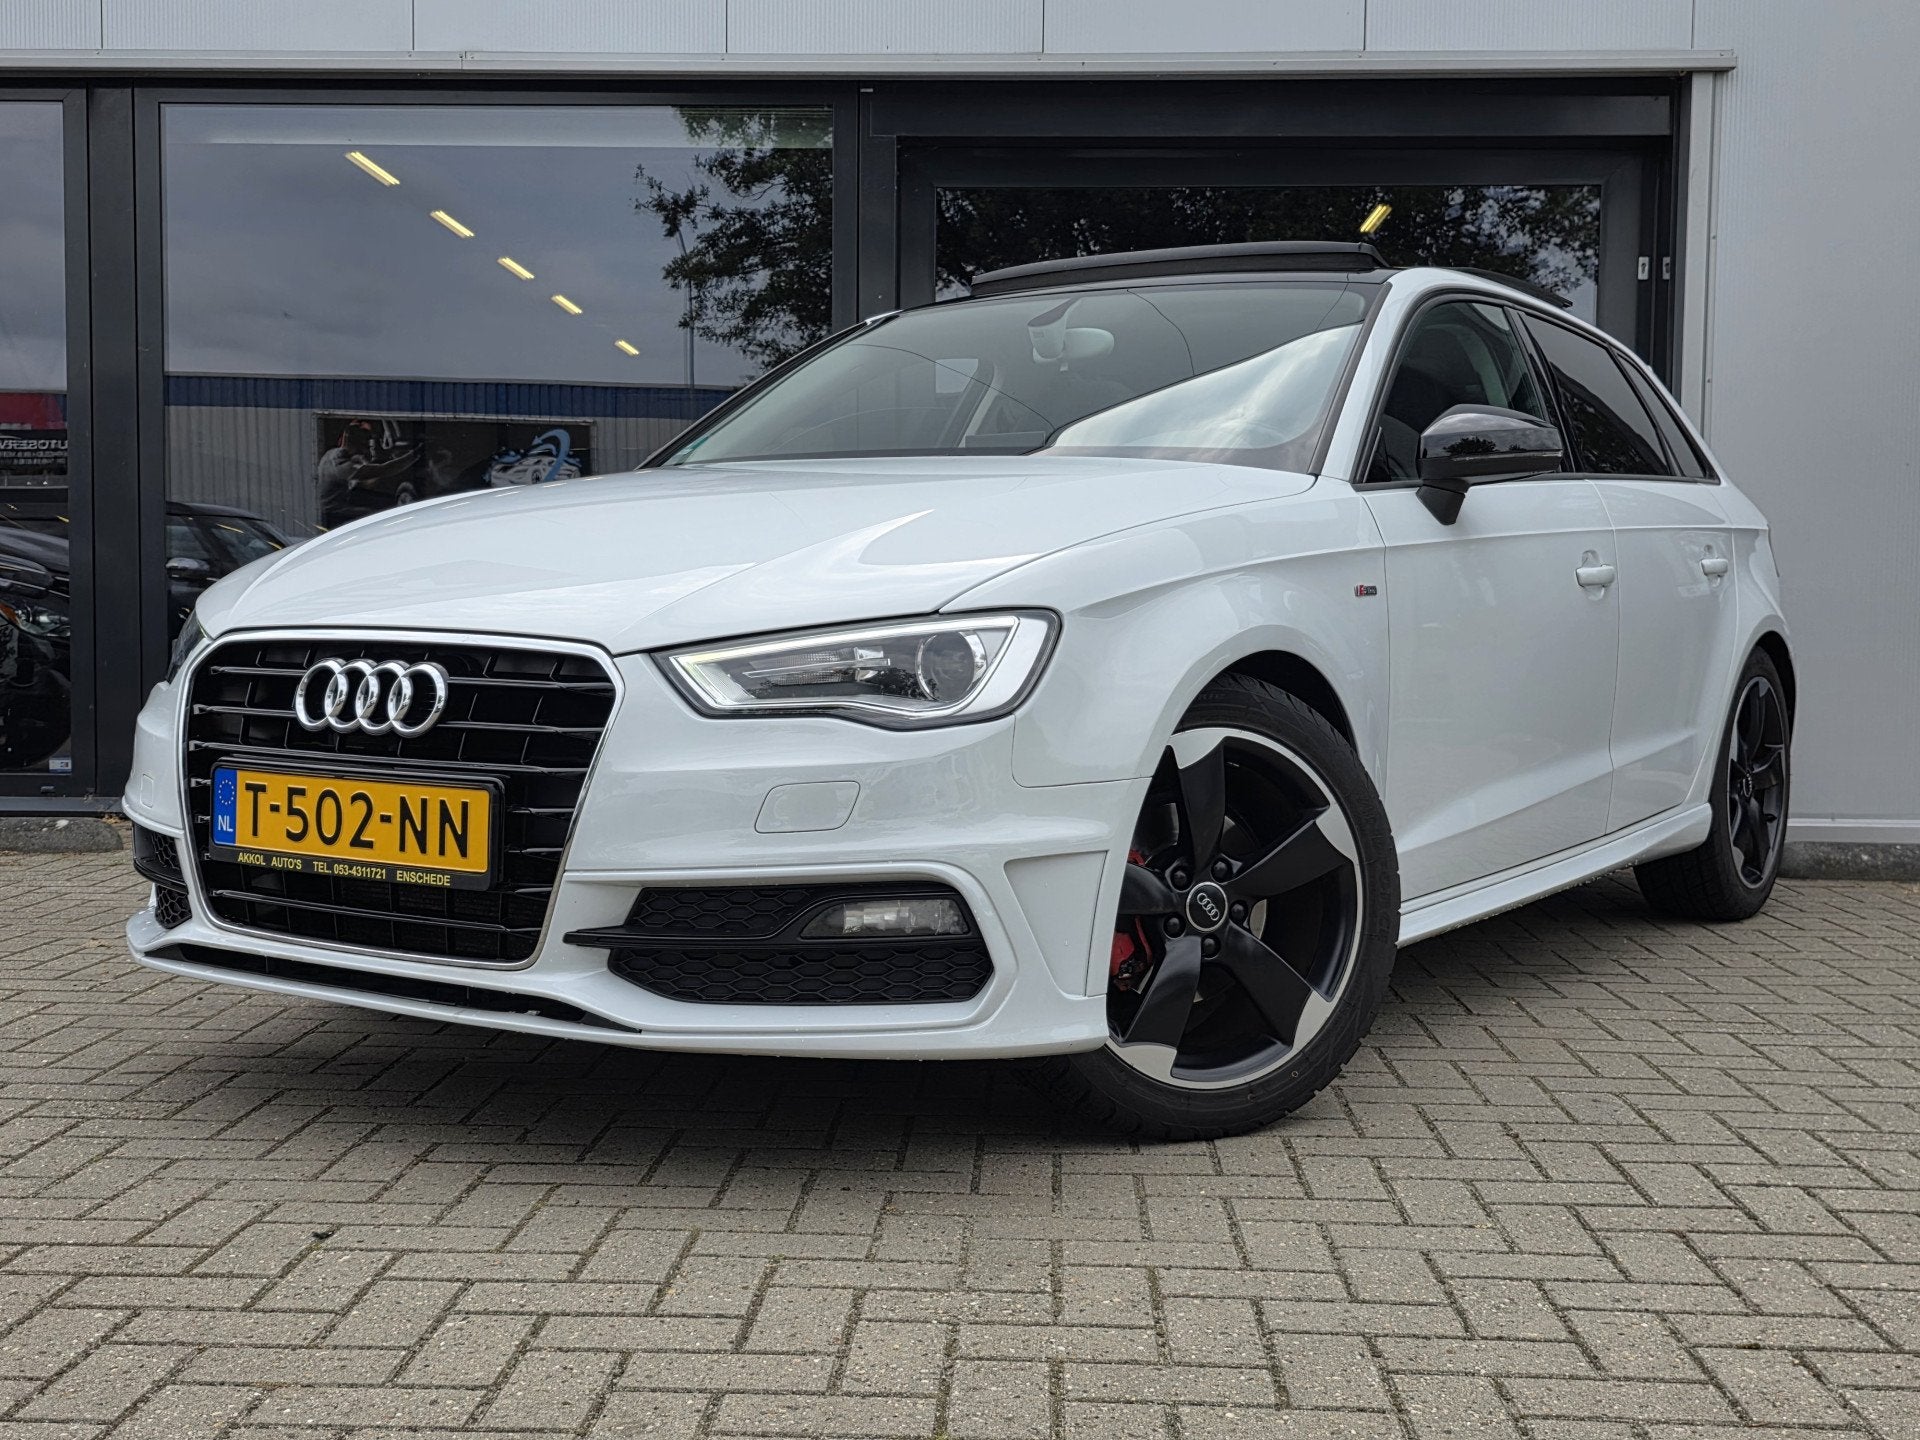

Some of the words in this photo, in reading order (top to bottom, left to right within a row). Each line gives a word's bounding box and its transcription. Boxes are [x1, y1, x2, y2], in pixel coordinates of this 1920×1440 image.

[217, 814, 234, 833] NL
[245, 781, 470, 858] T-502-NN
[237, 852, 266, 866] AKKOL
[271, 856, 302, 870] AUTO'S
[313, 861, 332, 874] TEL.
[333, 863, 386, 880] 053-4311721
[396, 870, 451, 886] ENSCHEDE
